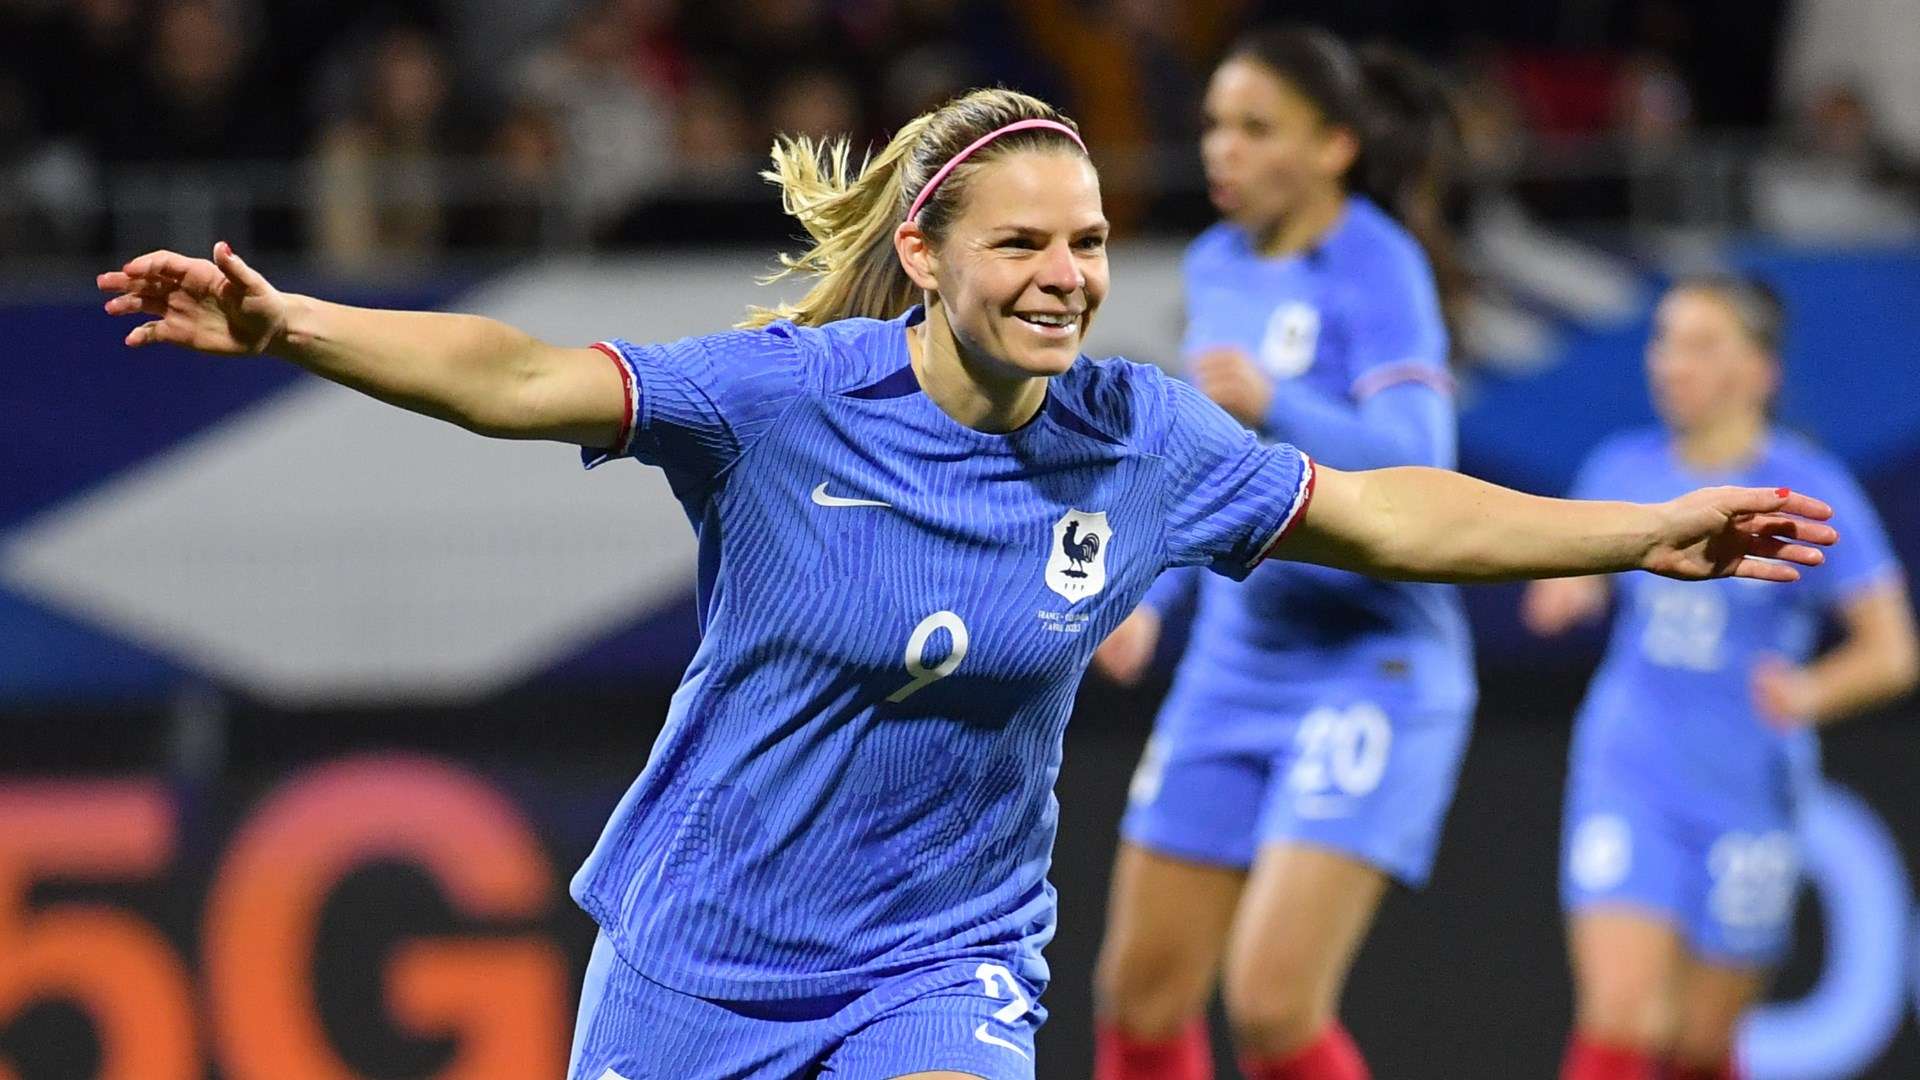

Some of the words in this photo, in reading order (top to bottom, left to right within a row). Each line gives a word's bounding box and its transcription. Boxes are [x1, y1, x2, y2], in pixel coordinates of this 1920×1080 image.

[885, 610, 968, 703] 9
[1291, 703, 1392, 797] 20
[0, 752, 569, 1080] 5G
